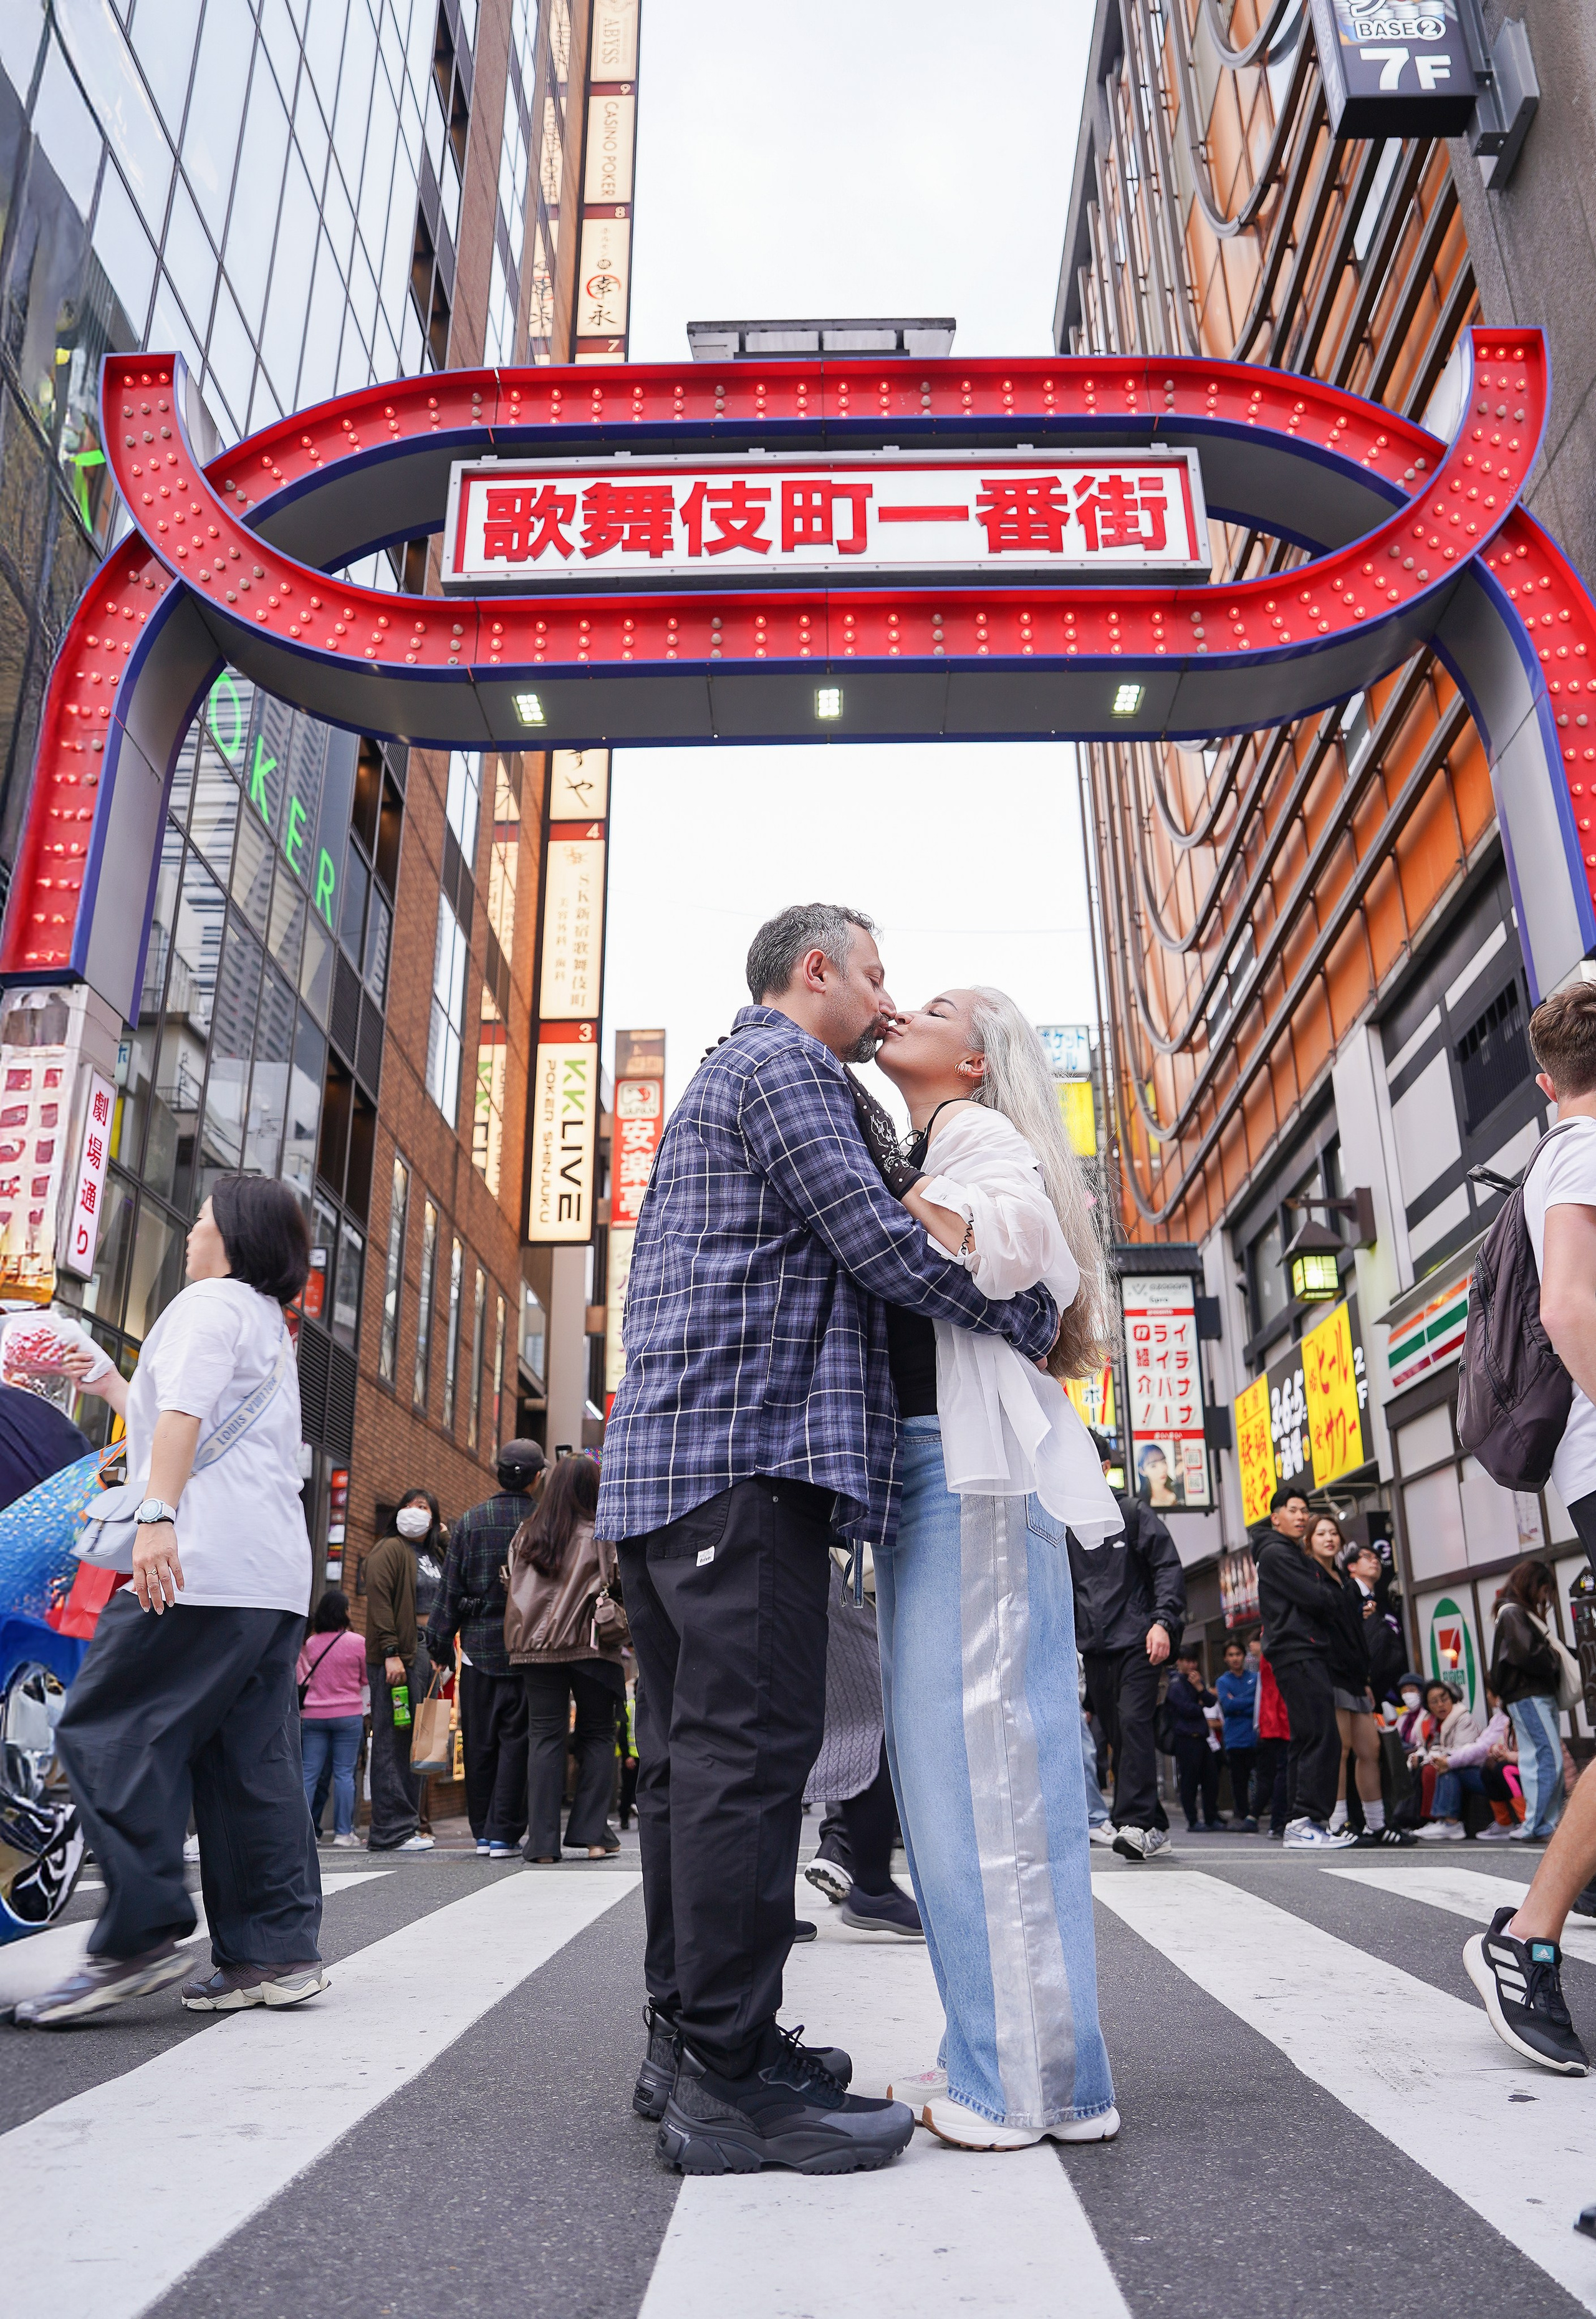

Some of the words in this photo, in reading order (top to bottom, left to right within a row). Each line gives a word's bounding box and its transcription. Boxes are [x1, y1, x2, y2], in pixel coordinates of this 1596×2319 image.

[602, 17, 620, 65] ABYSS
[620, 84, 632, 95] 9
[1359, 47, 1452, 91] 7F
[603, 101, 619, 151] CASINO
[600, 155, 617, 197] POKER
[614, 206, 626, 218] 8
[483, 474, 1168, 564] 歌舞伎町一番街
[585, 822, 600, 839] 4
[578, 1022, 593, 1042] 3
[544, 1059, 556, 1122] POKER
[74, 1090, 110, 1257] 劇場通り
[539, 1131, 553, 1223] SHINJUKU
[1353, 1346, 1368, 1410] 2F
[214, 1413, 247, 1446] LOUIS
